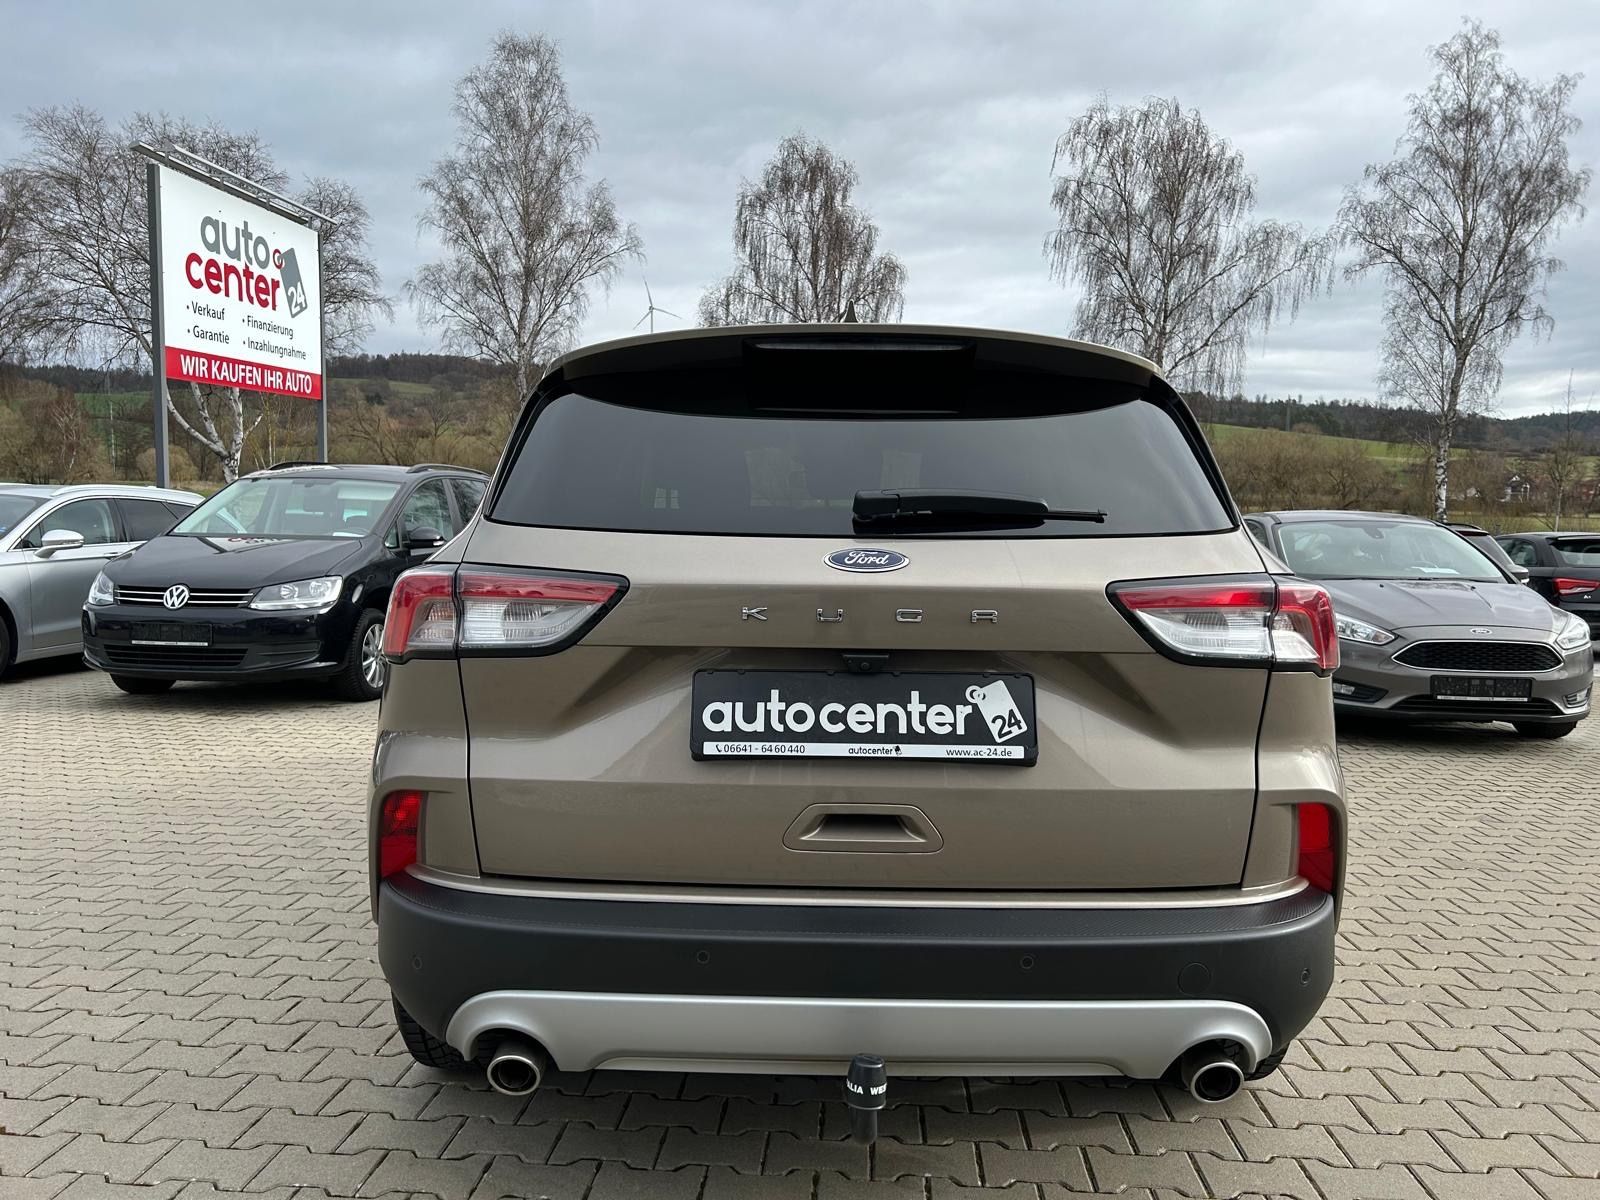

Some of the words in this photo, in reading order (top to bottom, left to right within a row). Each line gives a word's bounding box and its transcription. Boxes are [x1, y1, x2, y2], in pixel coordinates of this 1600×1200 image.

[201, 216, 270, 269] auto
[185, 252, 280, 311] center
[287, 281, 306, 313] 24
[191, 301, 225, 321] Verkauf
[192, 325, 230, 345] Garantie
[247, 315, 294, 340] Finanzierung
[247, 336, 307, 360] Inzahlungnahme
[180, 354, 208, 379] WIR
[211, 359, 262, 387] KAUFEN
[264, 368, 283, 390] IHR
[285, 372, 313, 394] AUTO
[844, 550, 889, 565] Ford
[702, 689, 973, 735] autocenter
[990, 708, 1024, 738] 24
[723, 744, 752, 753] 06641
[848, 747, 893, 755] autocenter
[946, 748, 1013, 757] www.ac-24.de
